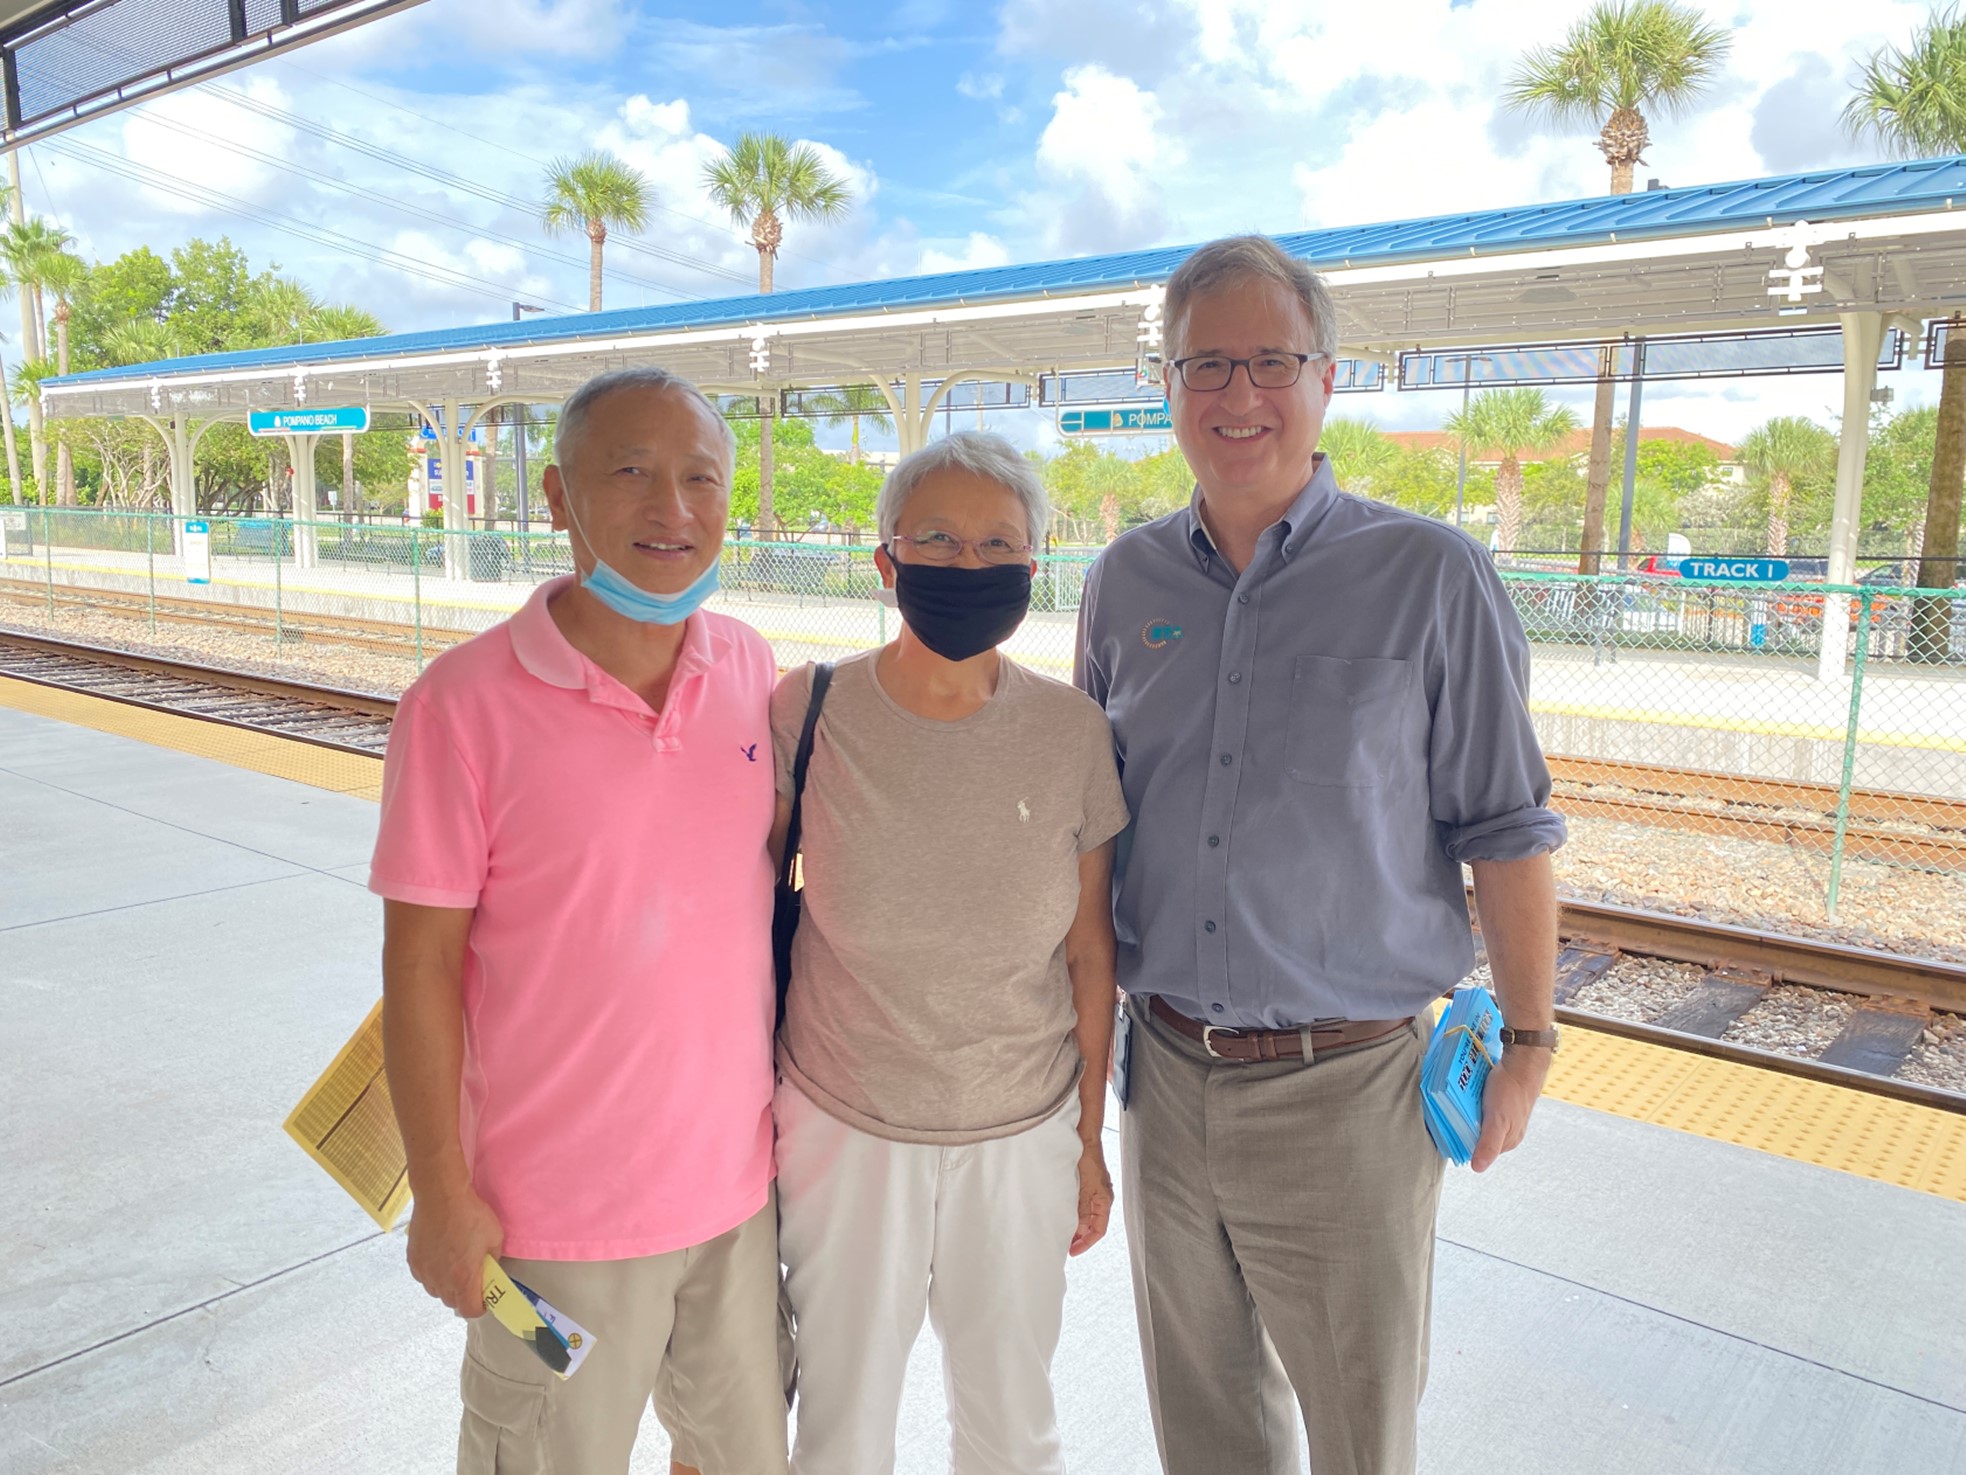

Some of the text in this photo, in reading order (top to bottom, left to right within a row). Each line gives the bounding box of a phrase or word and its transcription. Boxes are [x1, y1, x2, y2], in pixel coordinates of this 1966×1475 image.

[283, 413, 337, 427] POMPANO BEACH
[1690, 562, 1759, 578] TRACK
